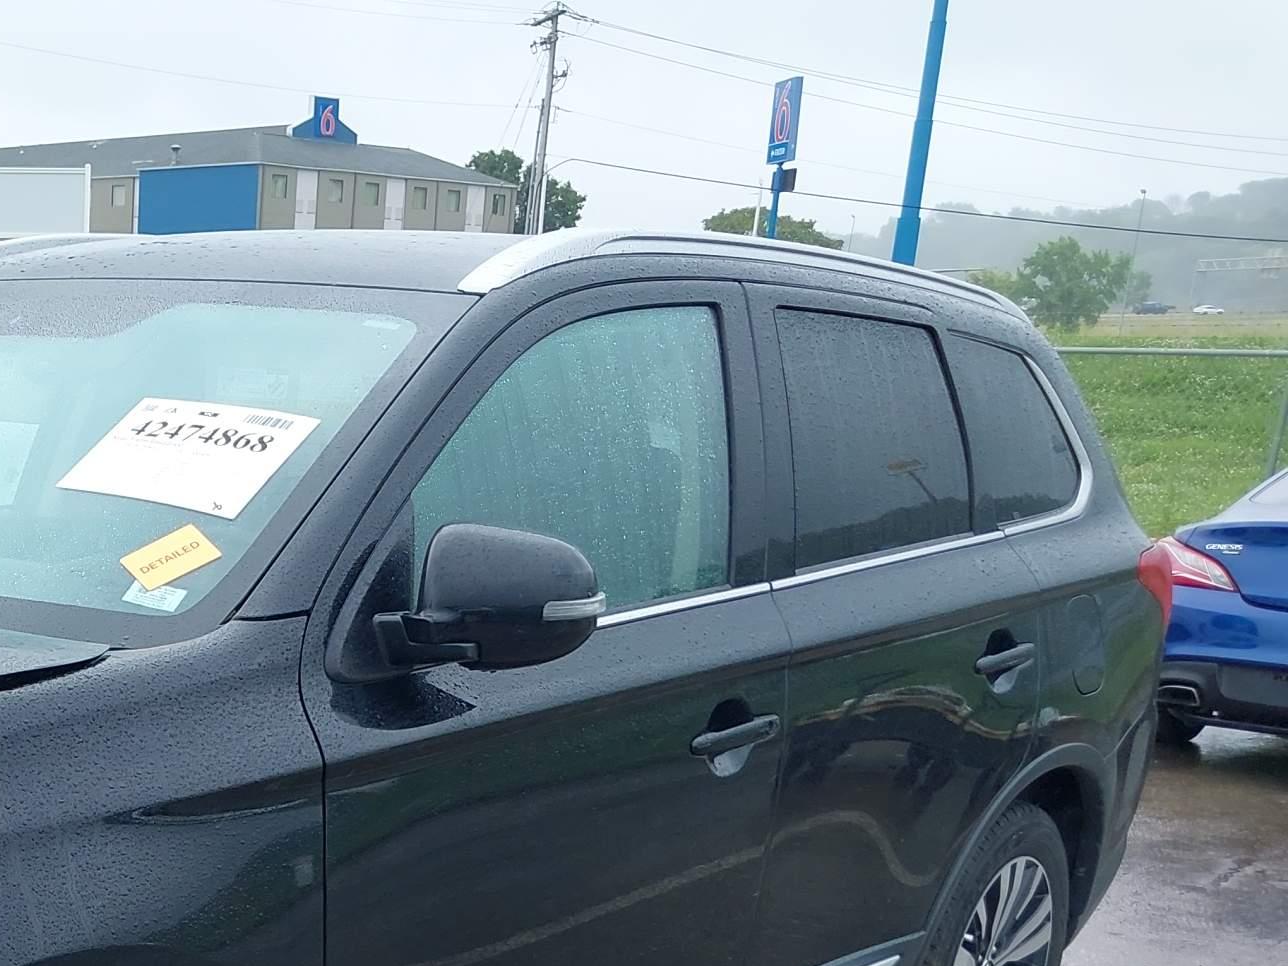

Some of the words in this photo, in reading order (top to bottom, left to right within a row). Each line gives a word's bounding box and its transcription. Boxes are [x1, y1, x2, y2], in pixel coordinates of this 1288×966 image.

[320, 105, 335, 136] 6
[775, 81, 791, 143] 6
[131, 420, 274, 453] 42474868
[139, 541, 200, 574] DETAILED
[1205, 543, 1243, 551] GENESIS
